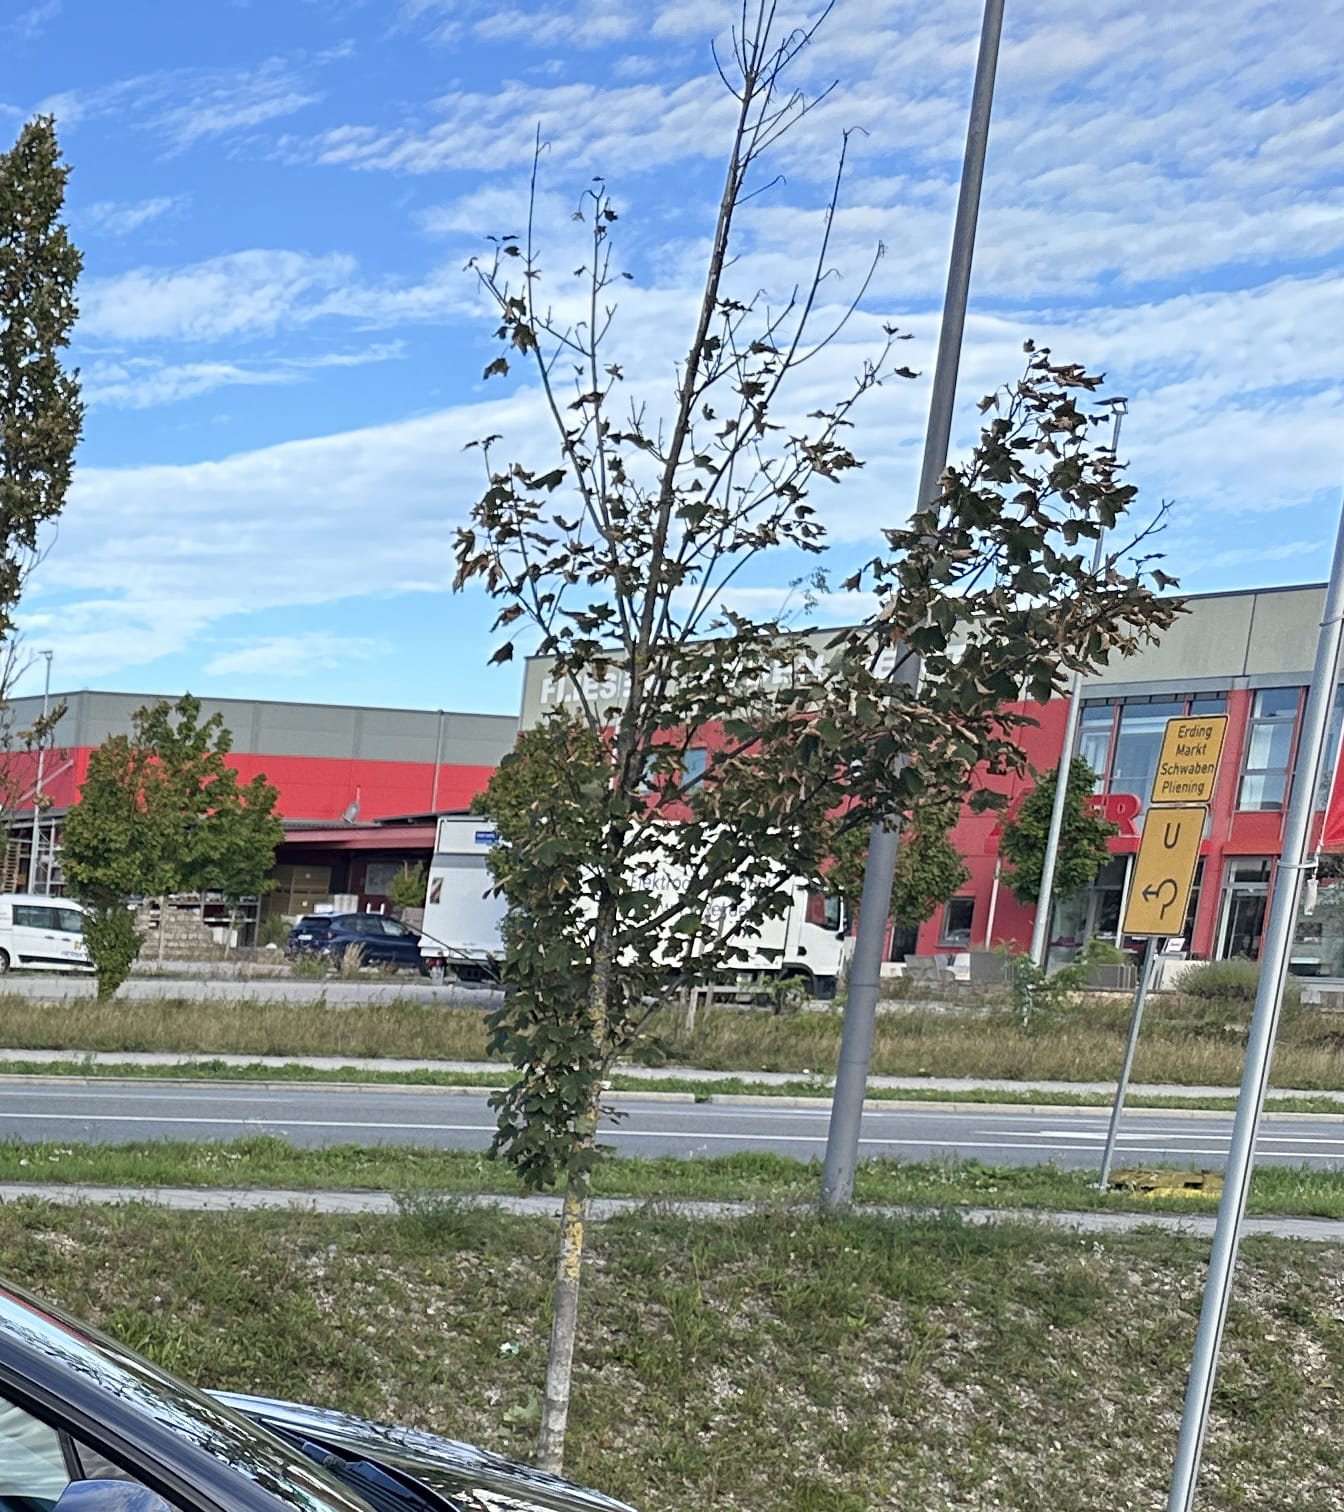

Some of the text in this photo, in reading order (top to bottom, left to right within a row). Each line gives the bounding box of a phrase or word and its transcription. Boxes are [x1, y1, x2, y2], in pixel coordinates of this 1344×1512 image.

[1177, 725, 1213, 740] Erding
[1175, 744, 1207, 757] Markt
[1160, 763, 1214, 776] Schwaben
[1161, 780, 1205, 796] Pliening
[1164, 822, 1181, 849] U
